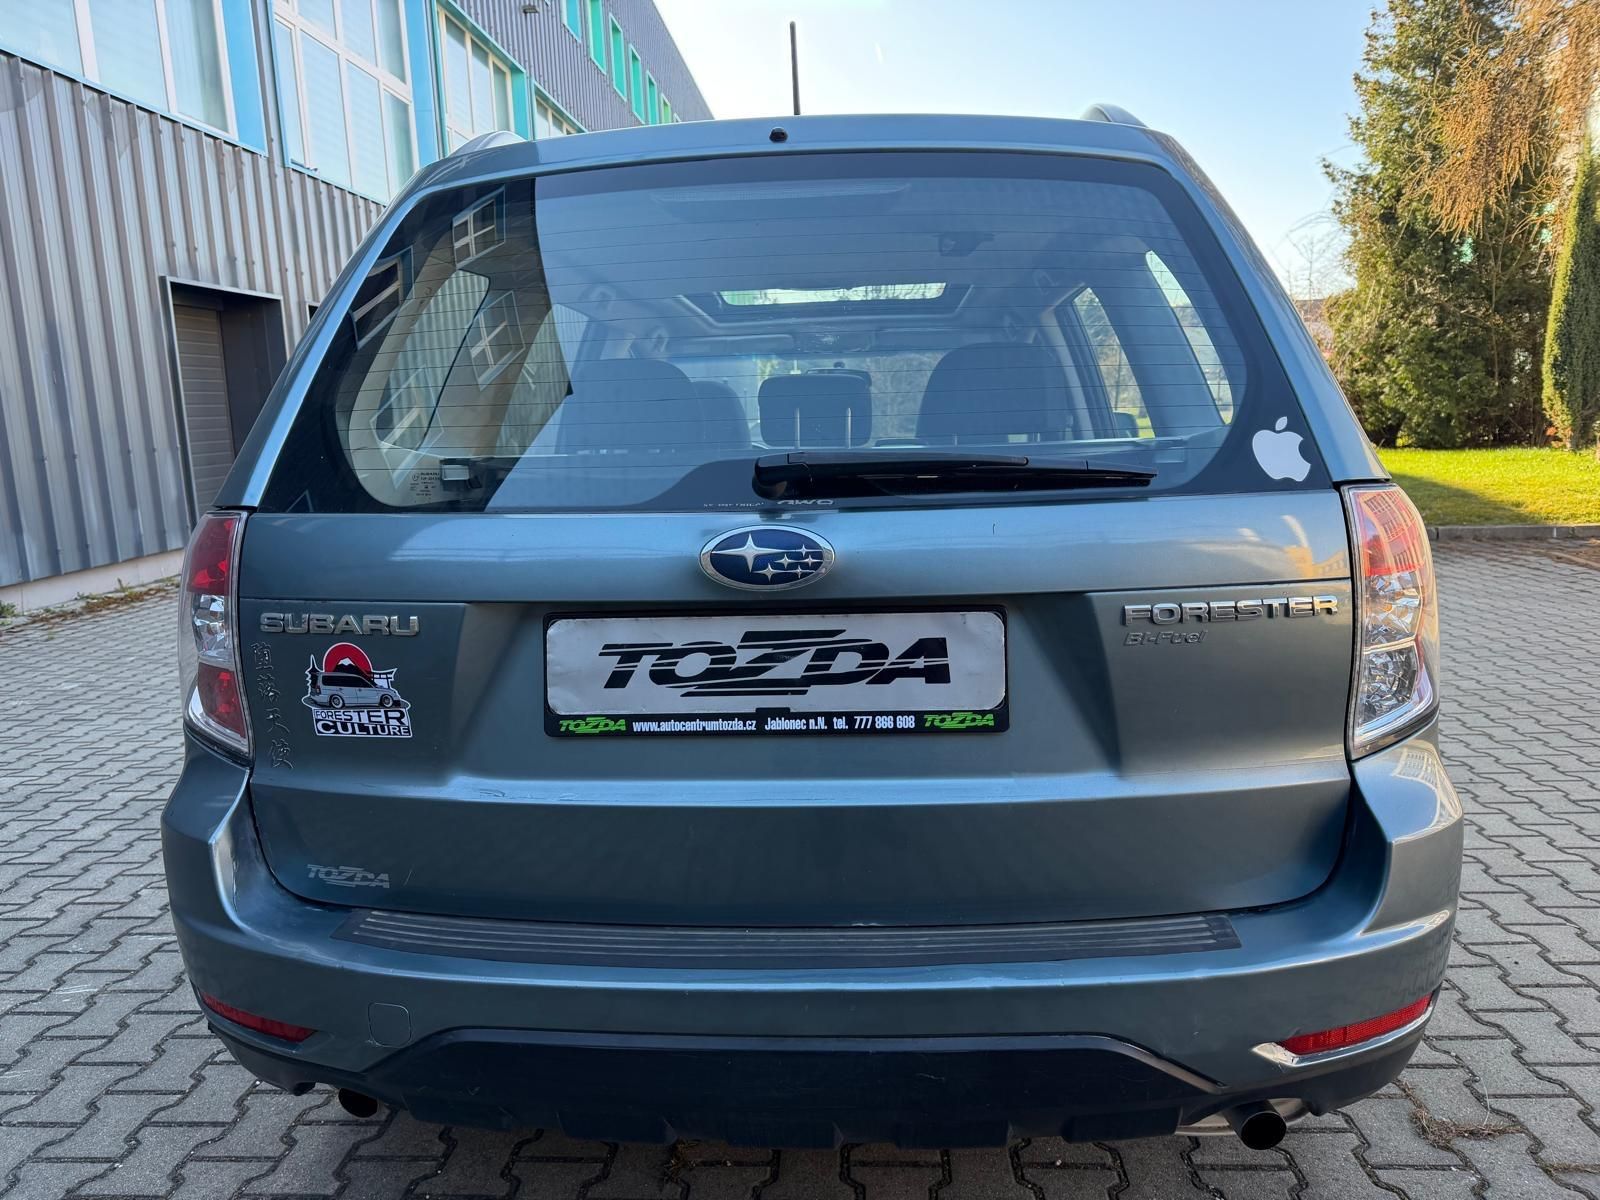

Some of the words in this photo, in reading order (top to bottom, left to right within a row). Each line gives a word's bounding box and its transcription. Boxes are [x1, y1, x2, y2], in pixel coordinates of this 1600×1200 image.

[1122, 595, 1338, 626] FORESTER
[260, 612, 420, 636] SUBARU
[1124, 630, 1208, 647] Bi-Fuel
[598, 629, 951, 697] TOZDA
[315, 709, 406, 726] FORESTER
[558, 717, 627, 734] TOZDA
[632, 717, 757, 732] www.autocentrumtozda.cz
[764, 717, 807, 731] Jablonec
[808, 717, 828, 730] n.N.
[832, 716, 849, 730] tel.
[854, 716, 873, 729] 777
[923, 712, 994, 729] TOZDA
[316, 720, 410, 736] CULTURE
[307, 864, 390, 889] TOZDA
